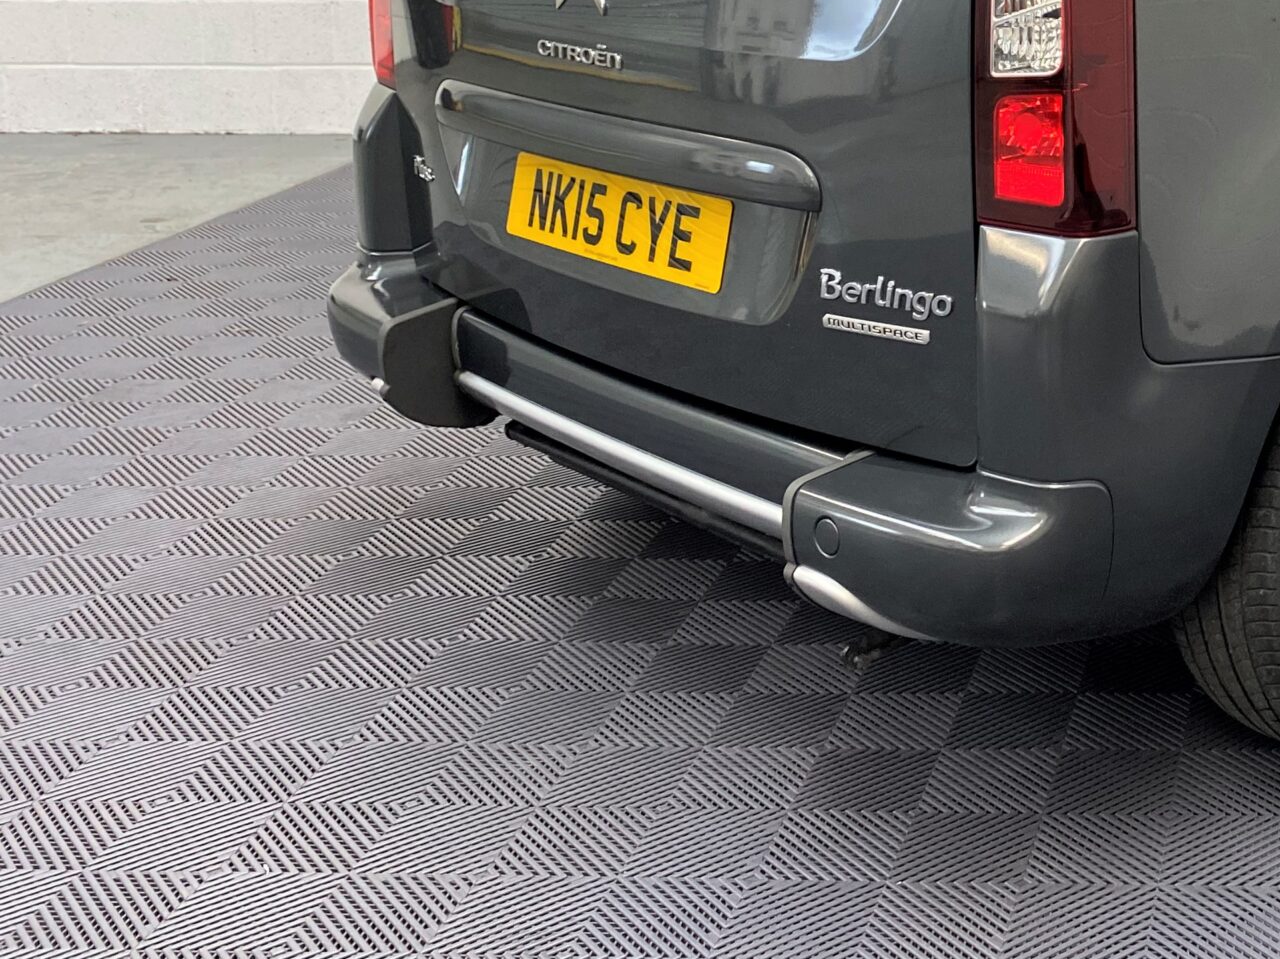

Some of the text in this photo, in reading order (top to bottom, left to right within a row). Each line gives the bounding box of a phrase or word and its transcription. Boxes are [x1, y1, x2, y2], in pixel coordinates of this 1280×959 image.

[536, 39, 624, 70] CITROËN
[527, 167, 702, 273] NK15 CYE
[819, 267, 953, 321] Berlingo
[827, 317, 924, 341] MULTISPACE
